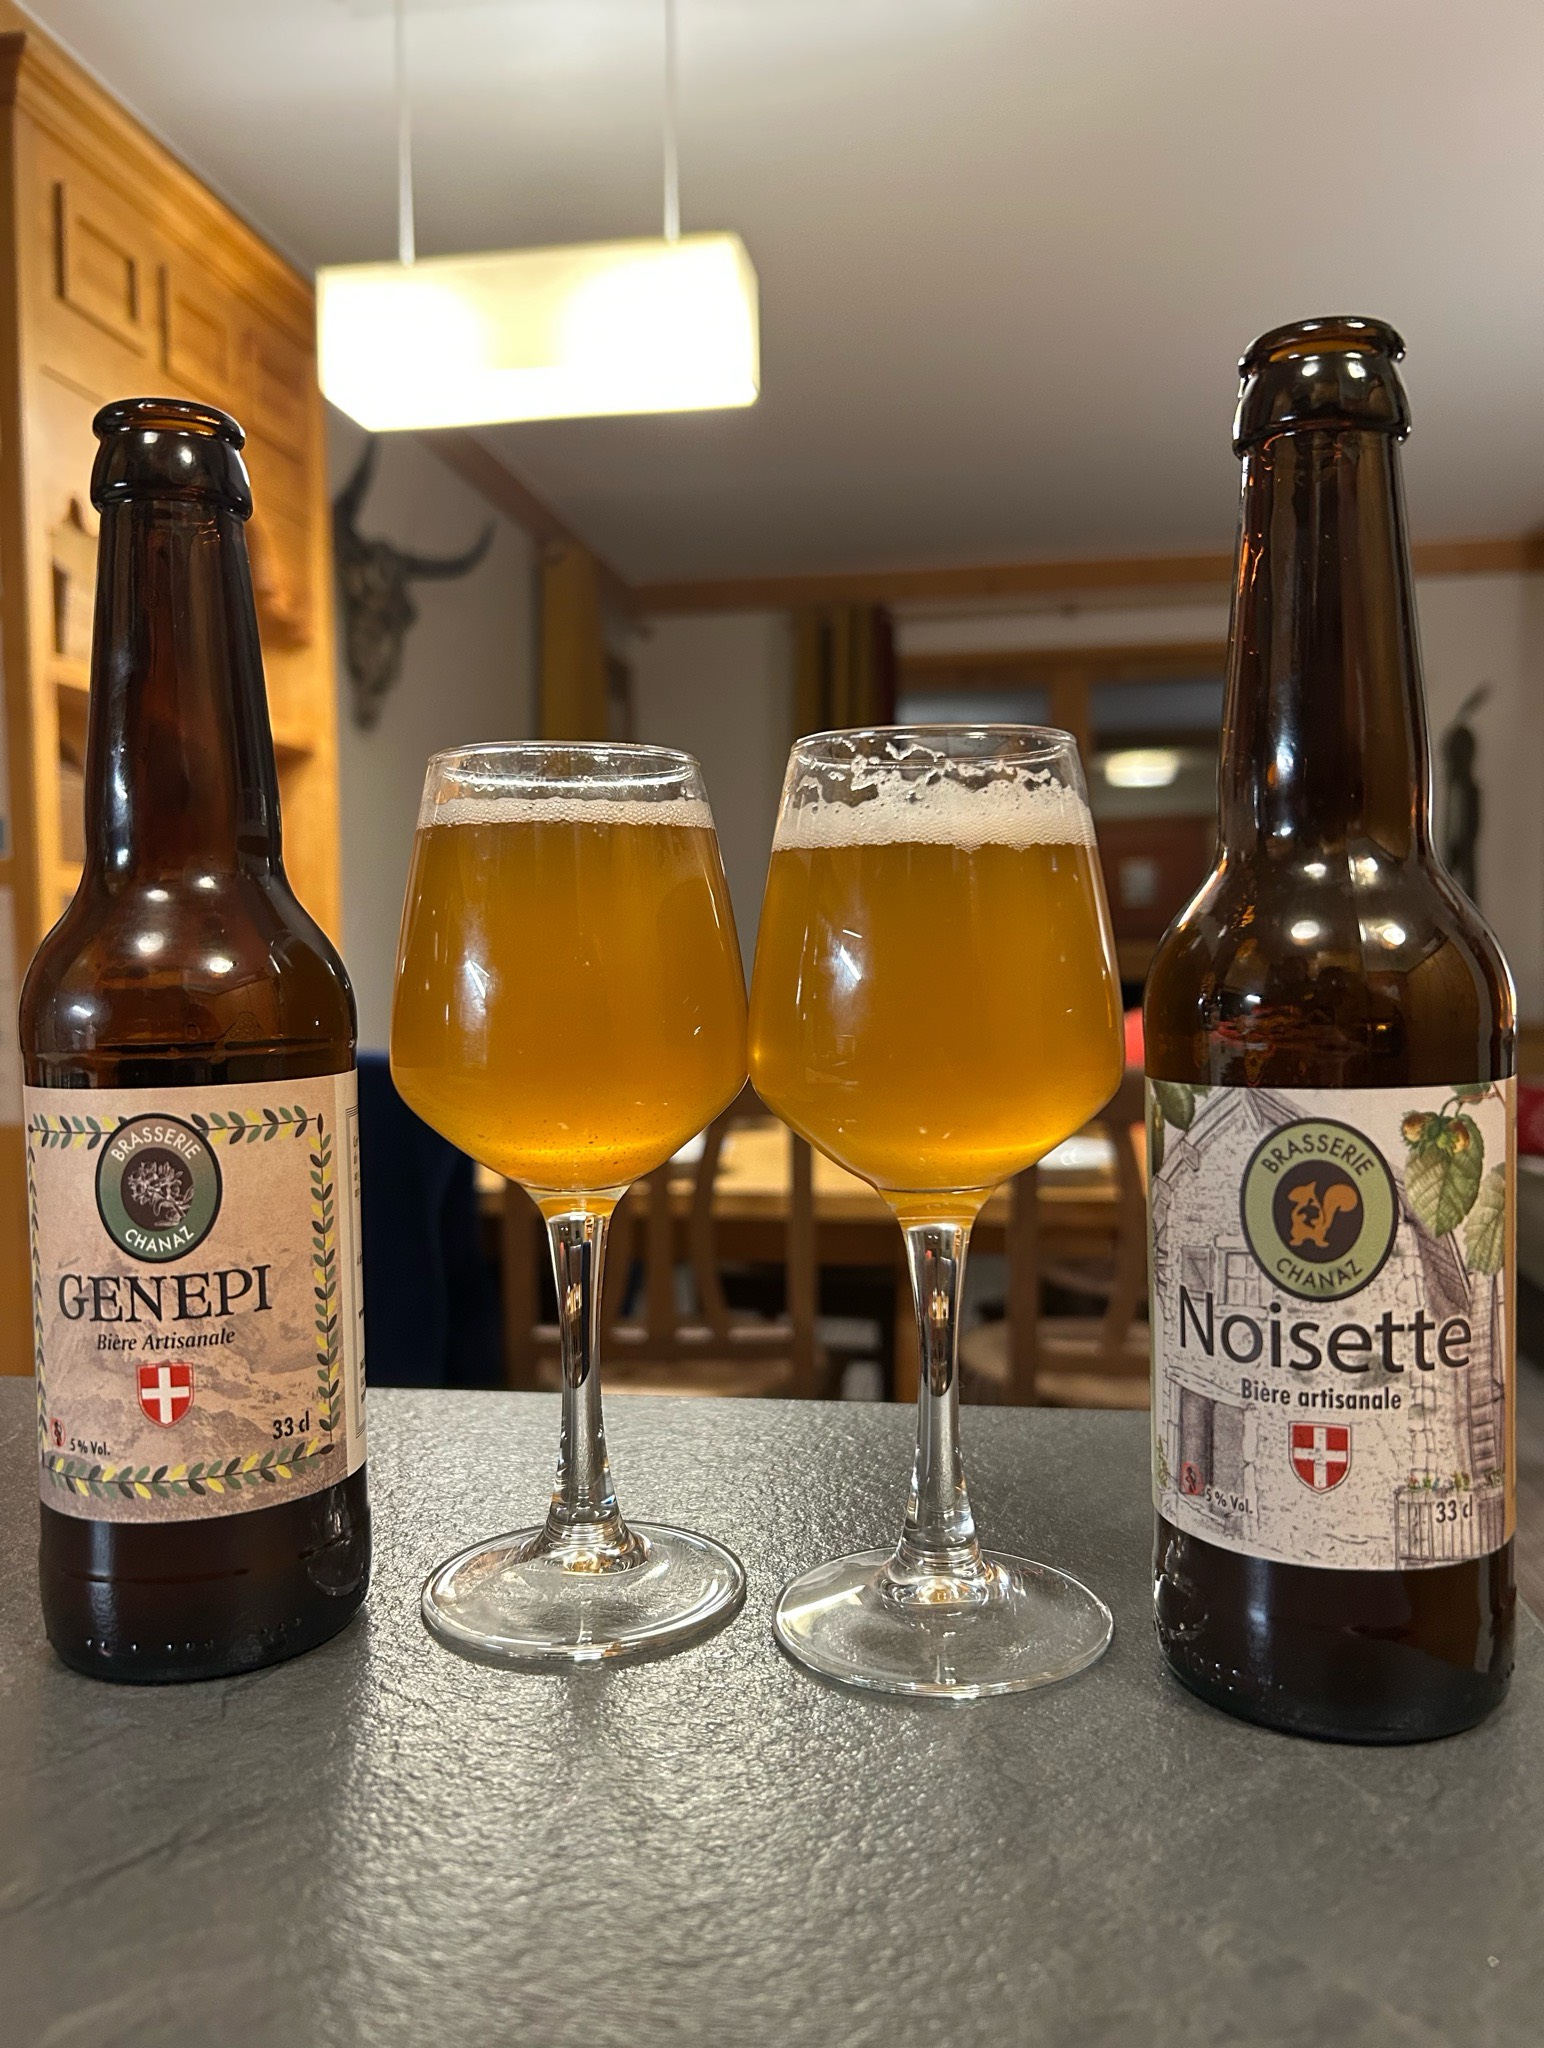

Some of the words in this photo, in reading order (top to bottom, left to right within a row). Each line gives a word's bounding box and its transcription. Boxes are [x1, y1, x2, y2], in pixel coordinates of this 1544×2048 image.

[111, 1126, 202, 1162] BRASSERIE
[1261, 1133, 1375, 1175] BRASSERIE
[125, 1225, 195, 1253] CHANAZ
[1276, 1257, 1363, 1290] CHANAZ
[59, 1264, 272, 1324] GENEPI
[97, 1334, 137, 1352] Bière
[142, 1328, 236, 1350] Artisanale
[1179, 1284, 1472, 1373] Noisette
[1240, 1378, 1291, 1406] Bière
[1297, 1387, 1402, 1410] artisanale
[272, 1419, 295, 1440] 33
[298, 1411, 311, 1433] cl
[90, 1441, 111, 1455] Vol.
[1230, 1495, 1253, 1514] Vol.
[1436, 1500, 1459, 1523] 33
[1462, 1496, 1473, 1518] cl
